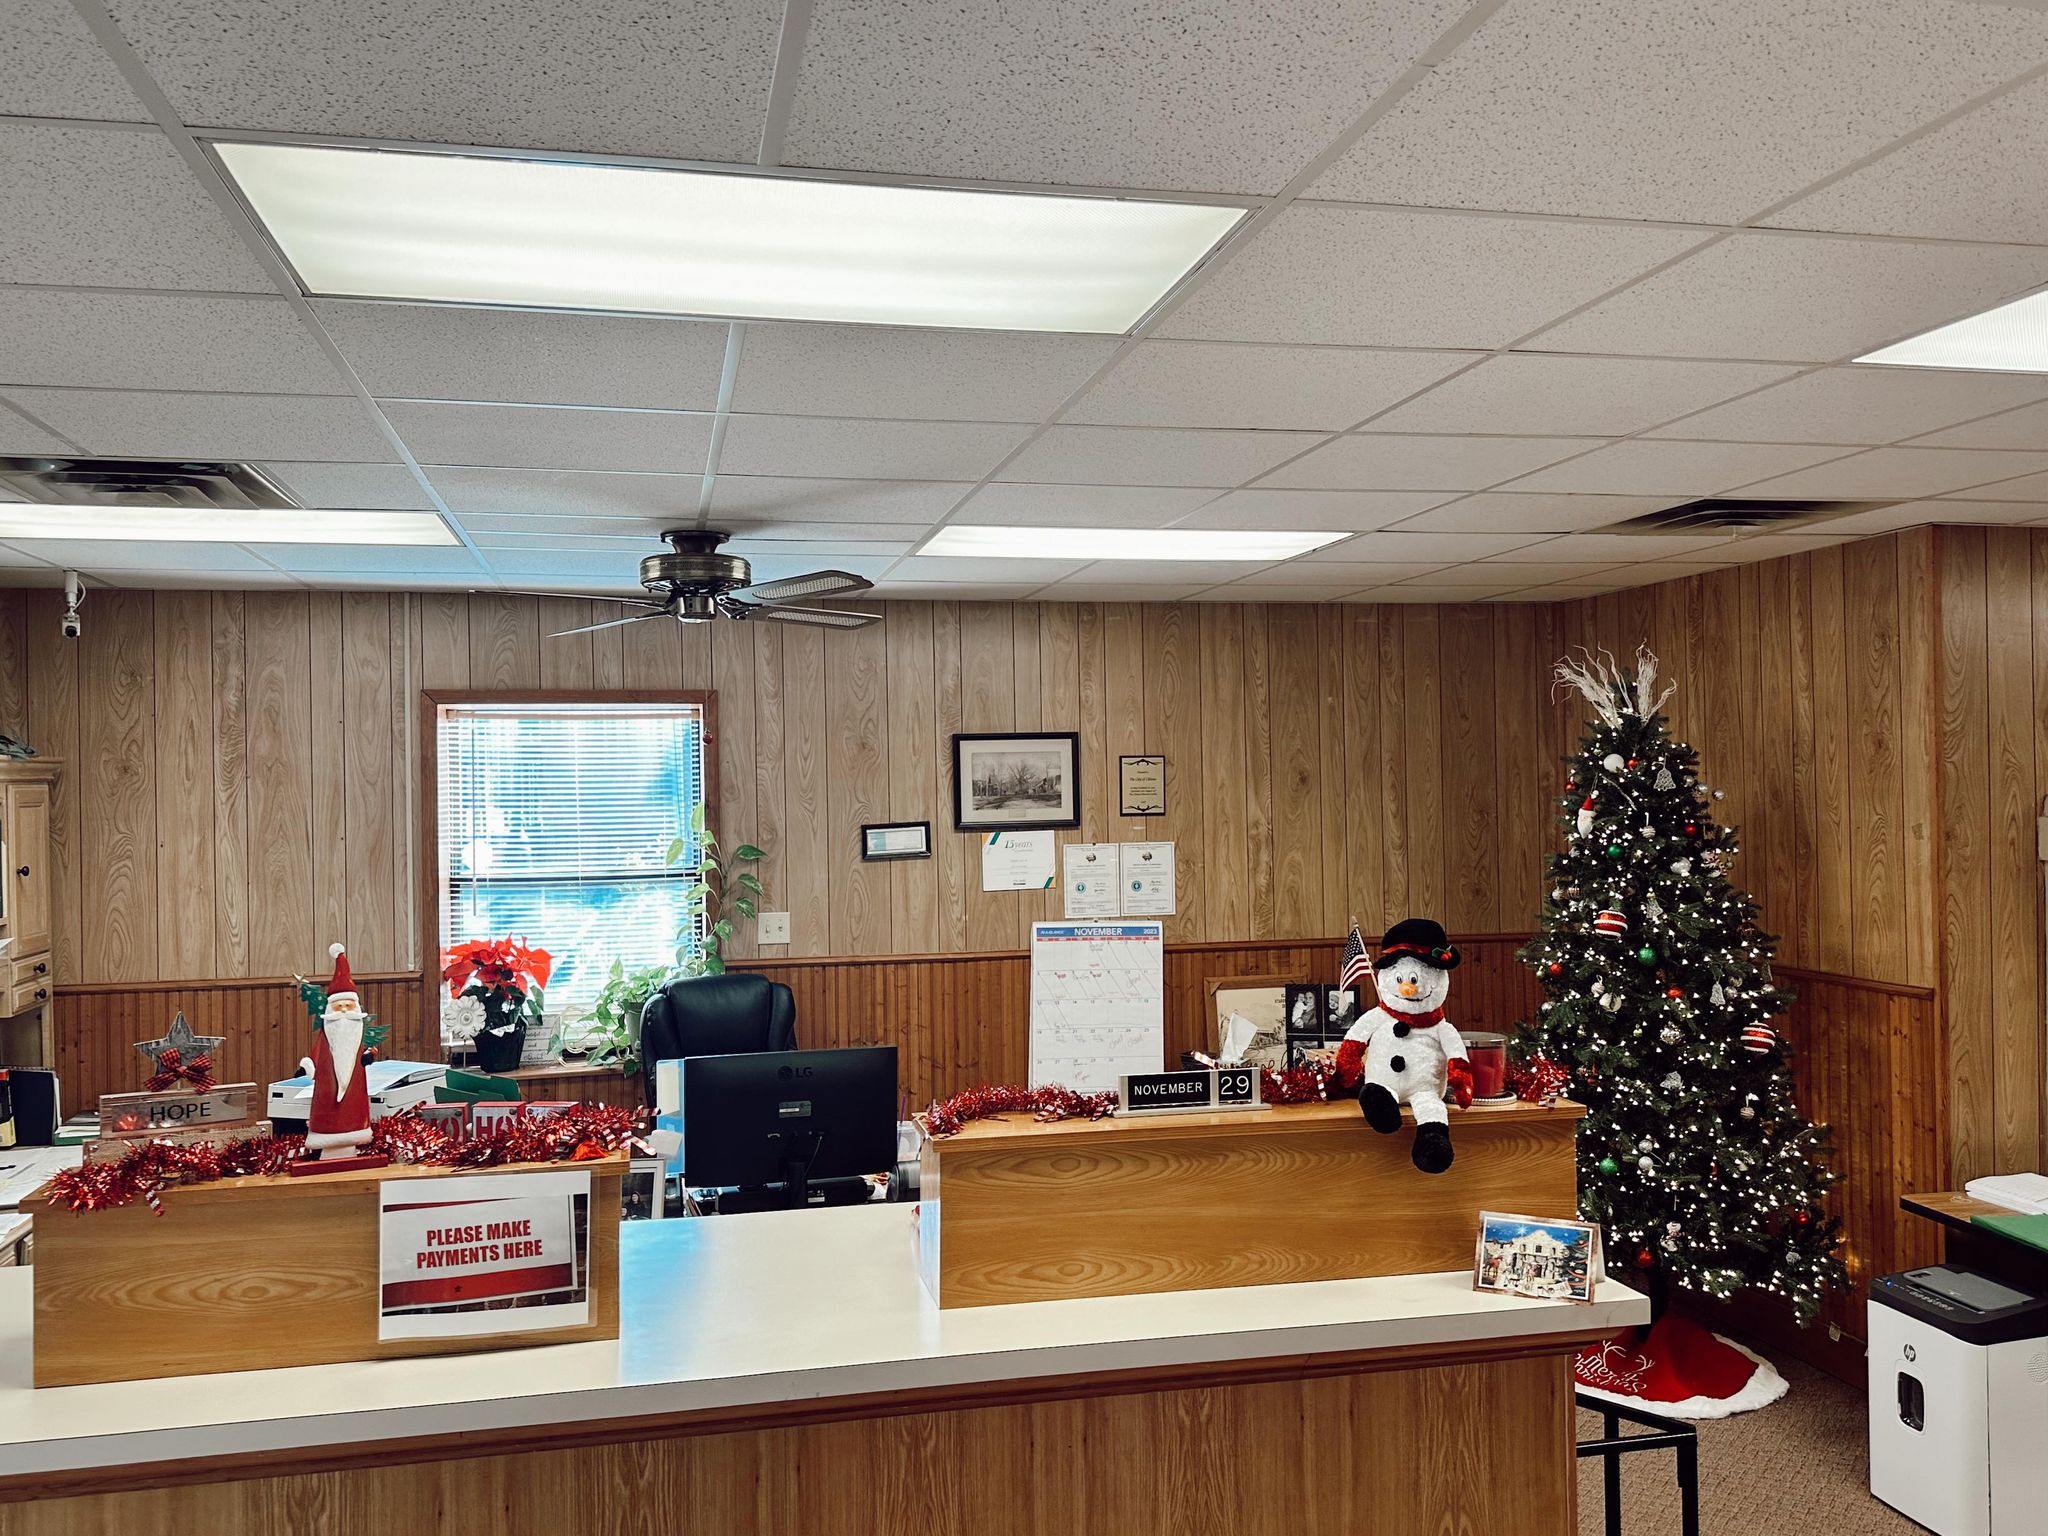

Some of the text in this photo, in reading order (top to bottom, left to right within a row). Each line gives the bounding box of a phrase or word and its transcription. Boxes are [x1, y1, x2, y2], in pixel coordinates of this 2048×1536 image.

[1005, 840, 1014, 848] 15
[1074, 927, 1122, 936] NOVEMBER
[795, 1067, 813, 1078] LG
[1134, 1082, 1203, 1096] NOVEMBER
[1220, 1075, 1250, 1095] 29
[150, 1101, 212, 1121] HOPE
[426, 1219, 531, 1247] PLEASE MAKE
[416, 1239, 543, 1269] PAYMENTS HERE
[1904, 1344, 1916, 1362] hp
